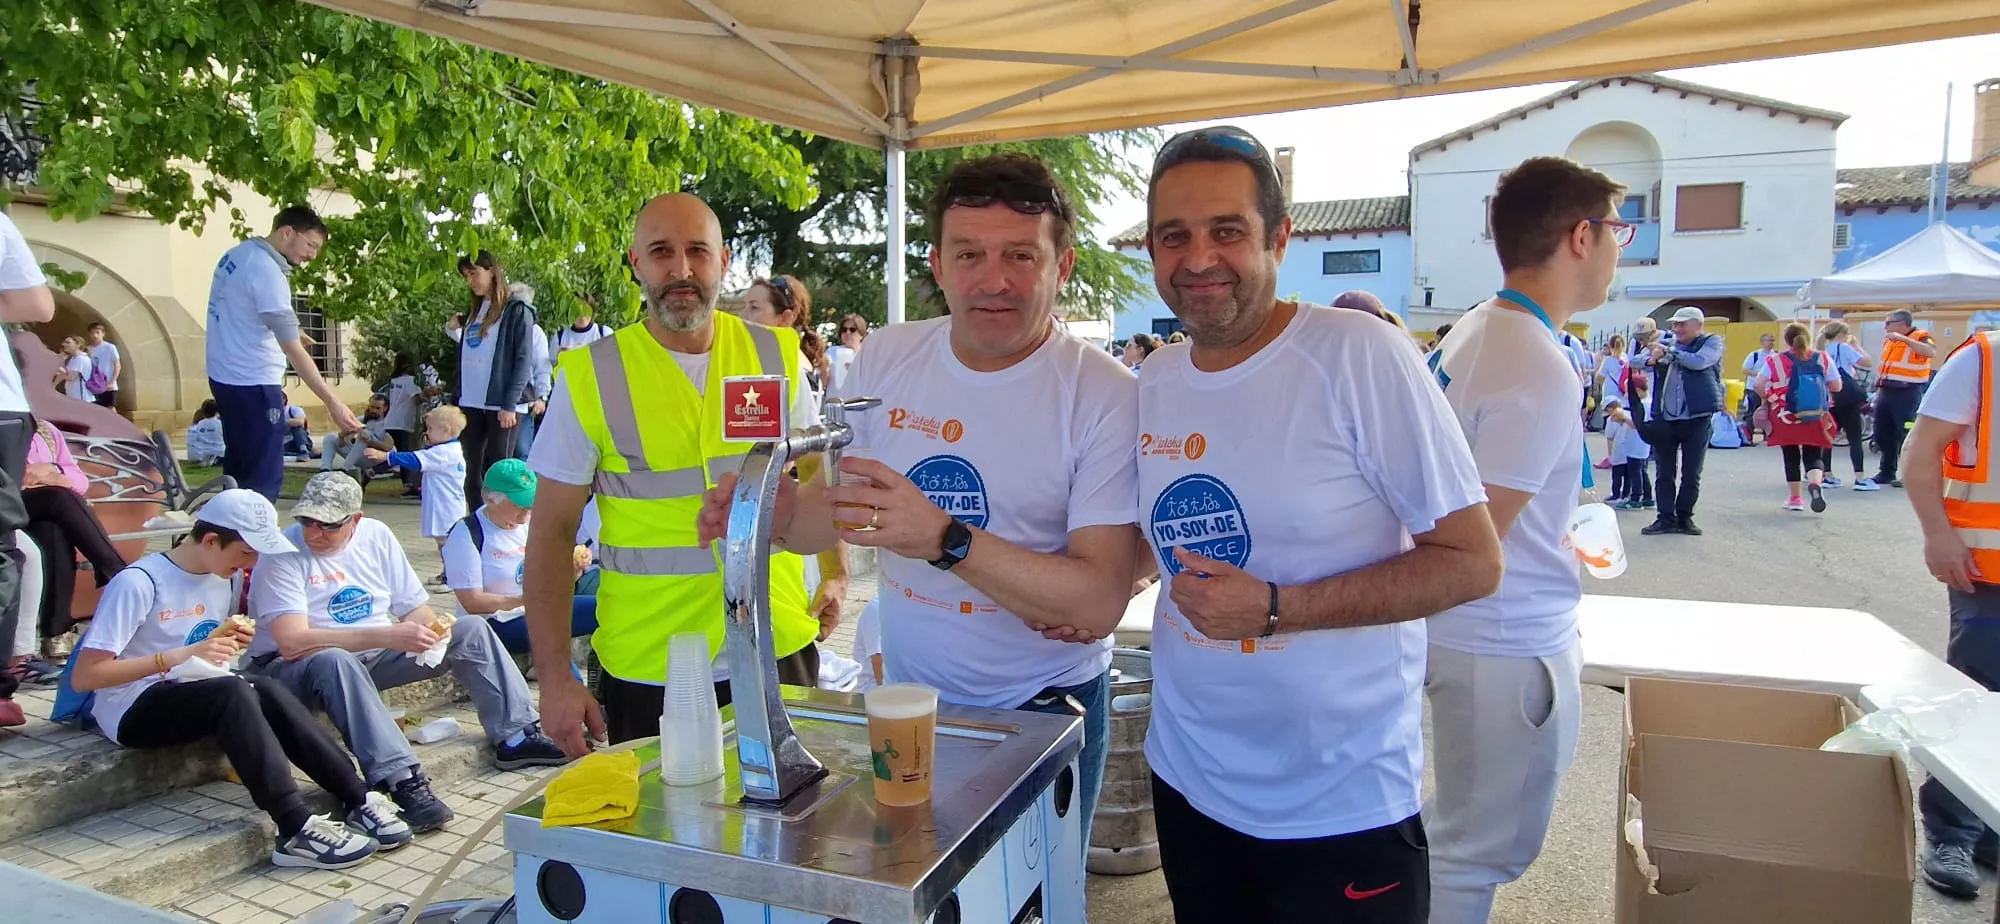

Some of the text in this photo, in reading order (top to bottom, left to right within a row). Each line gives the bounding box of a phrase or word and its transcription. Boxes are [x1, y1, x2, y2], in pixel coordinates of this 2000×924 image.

[734, 403, 769, 416] Estrella
[888, 407, 906, 430] 12
[1140, 432, 1153, 456] 2
